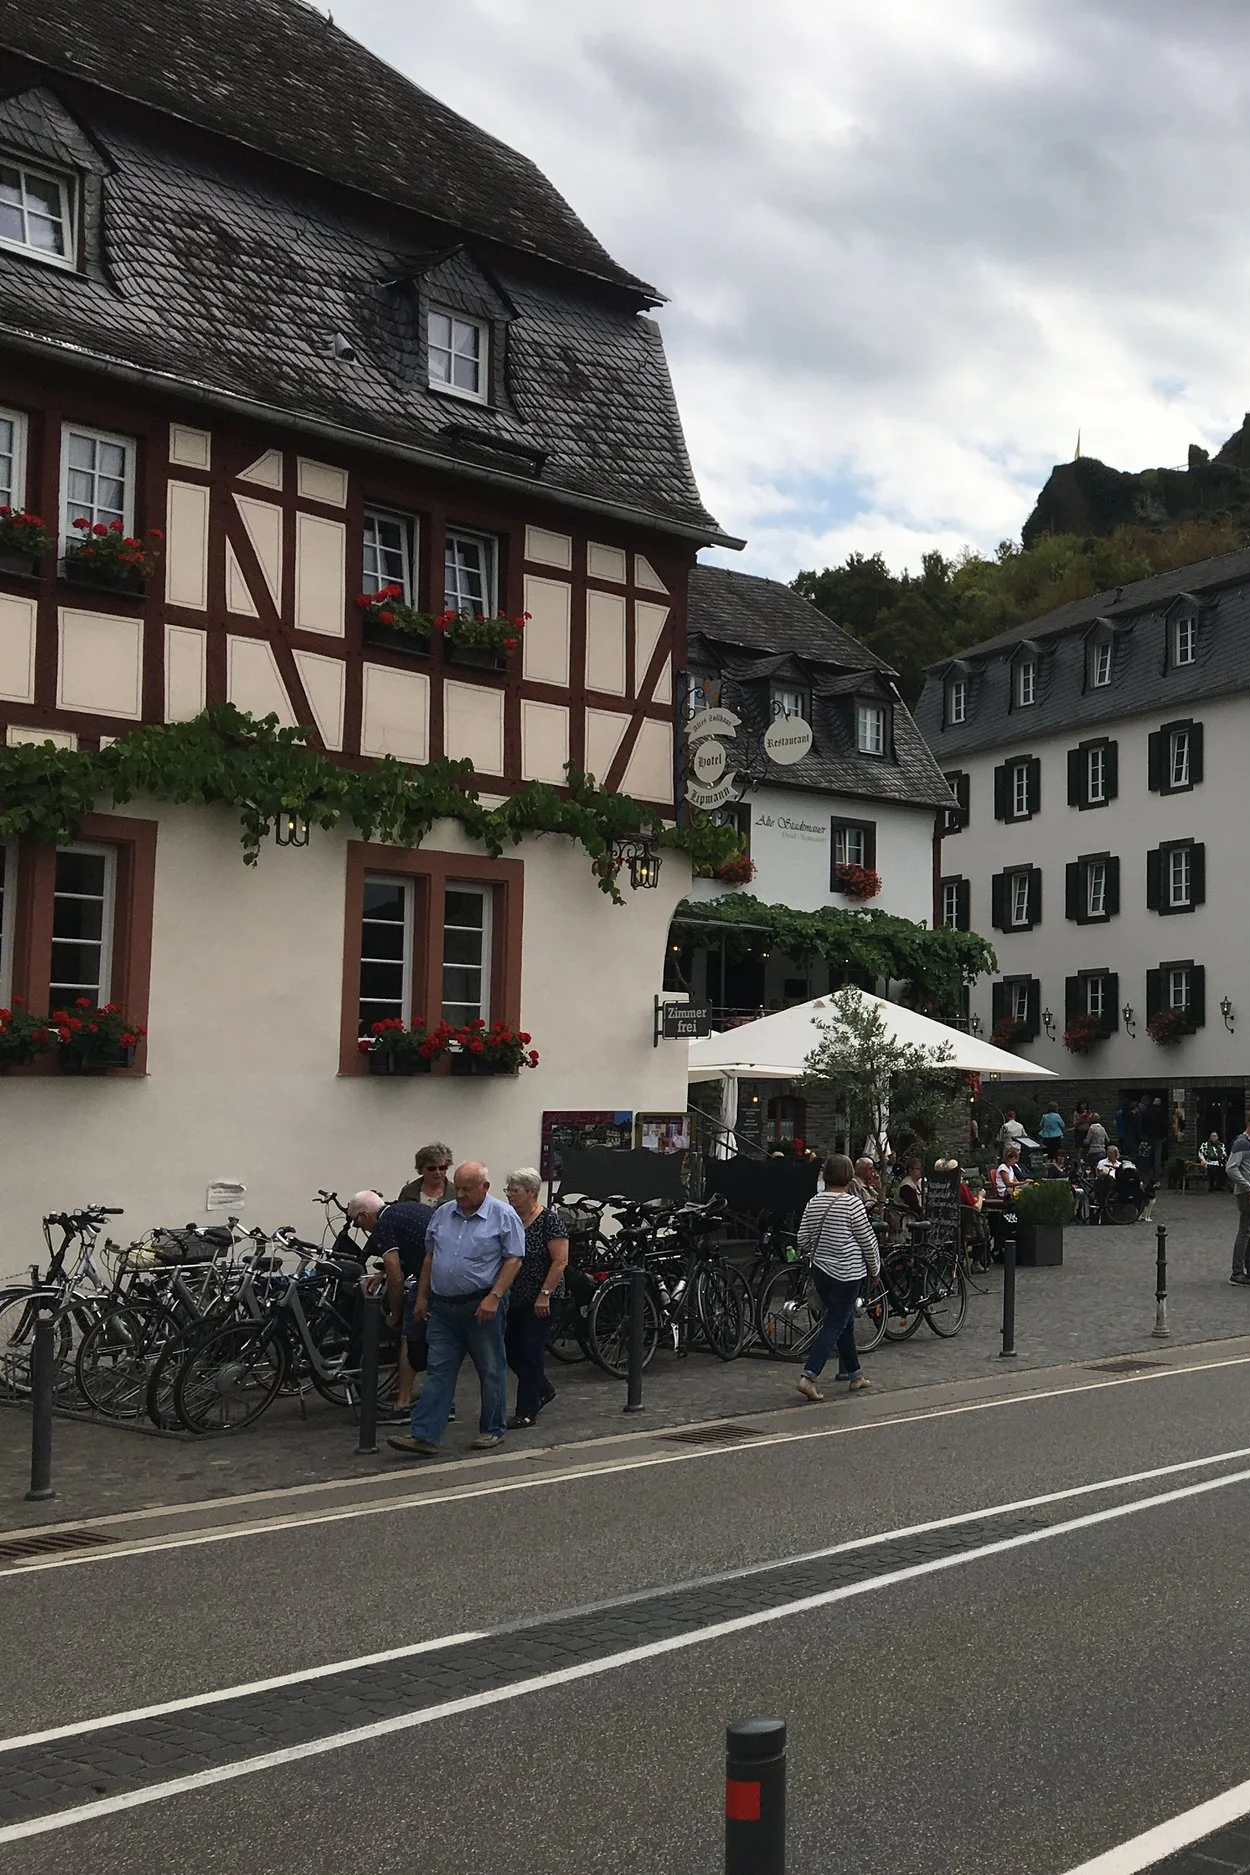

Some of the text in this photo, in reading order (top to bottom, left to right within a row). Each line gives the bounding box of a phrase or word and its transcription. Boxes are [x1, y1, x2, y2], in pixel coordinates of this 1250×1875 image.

[767, 734, 810, 748] Restaurant
[698, 753, 722, 768] Hotel
[691, 786, 730, 806] Lipmann
[755, 814, 775, 827] Alte
[668, 1007, 707, 1019] Zimmer
[677, 1020, 697, 1033] frei
